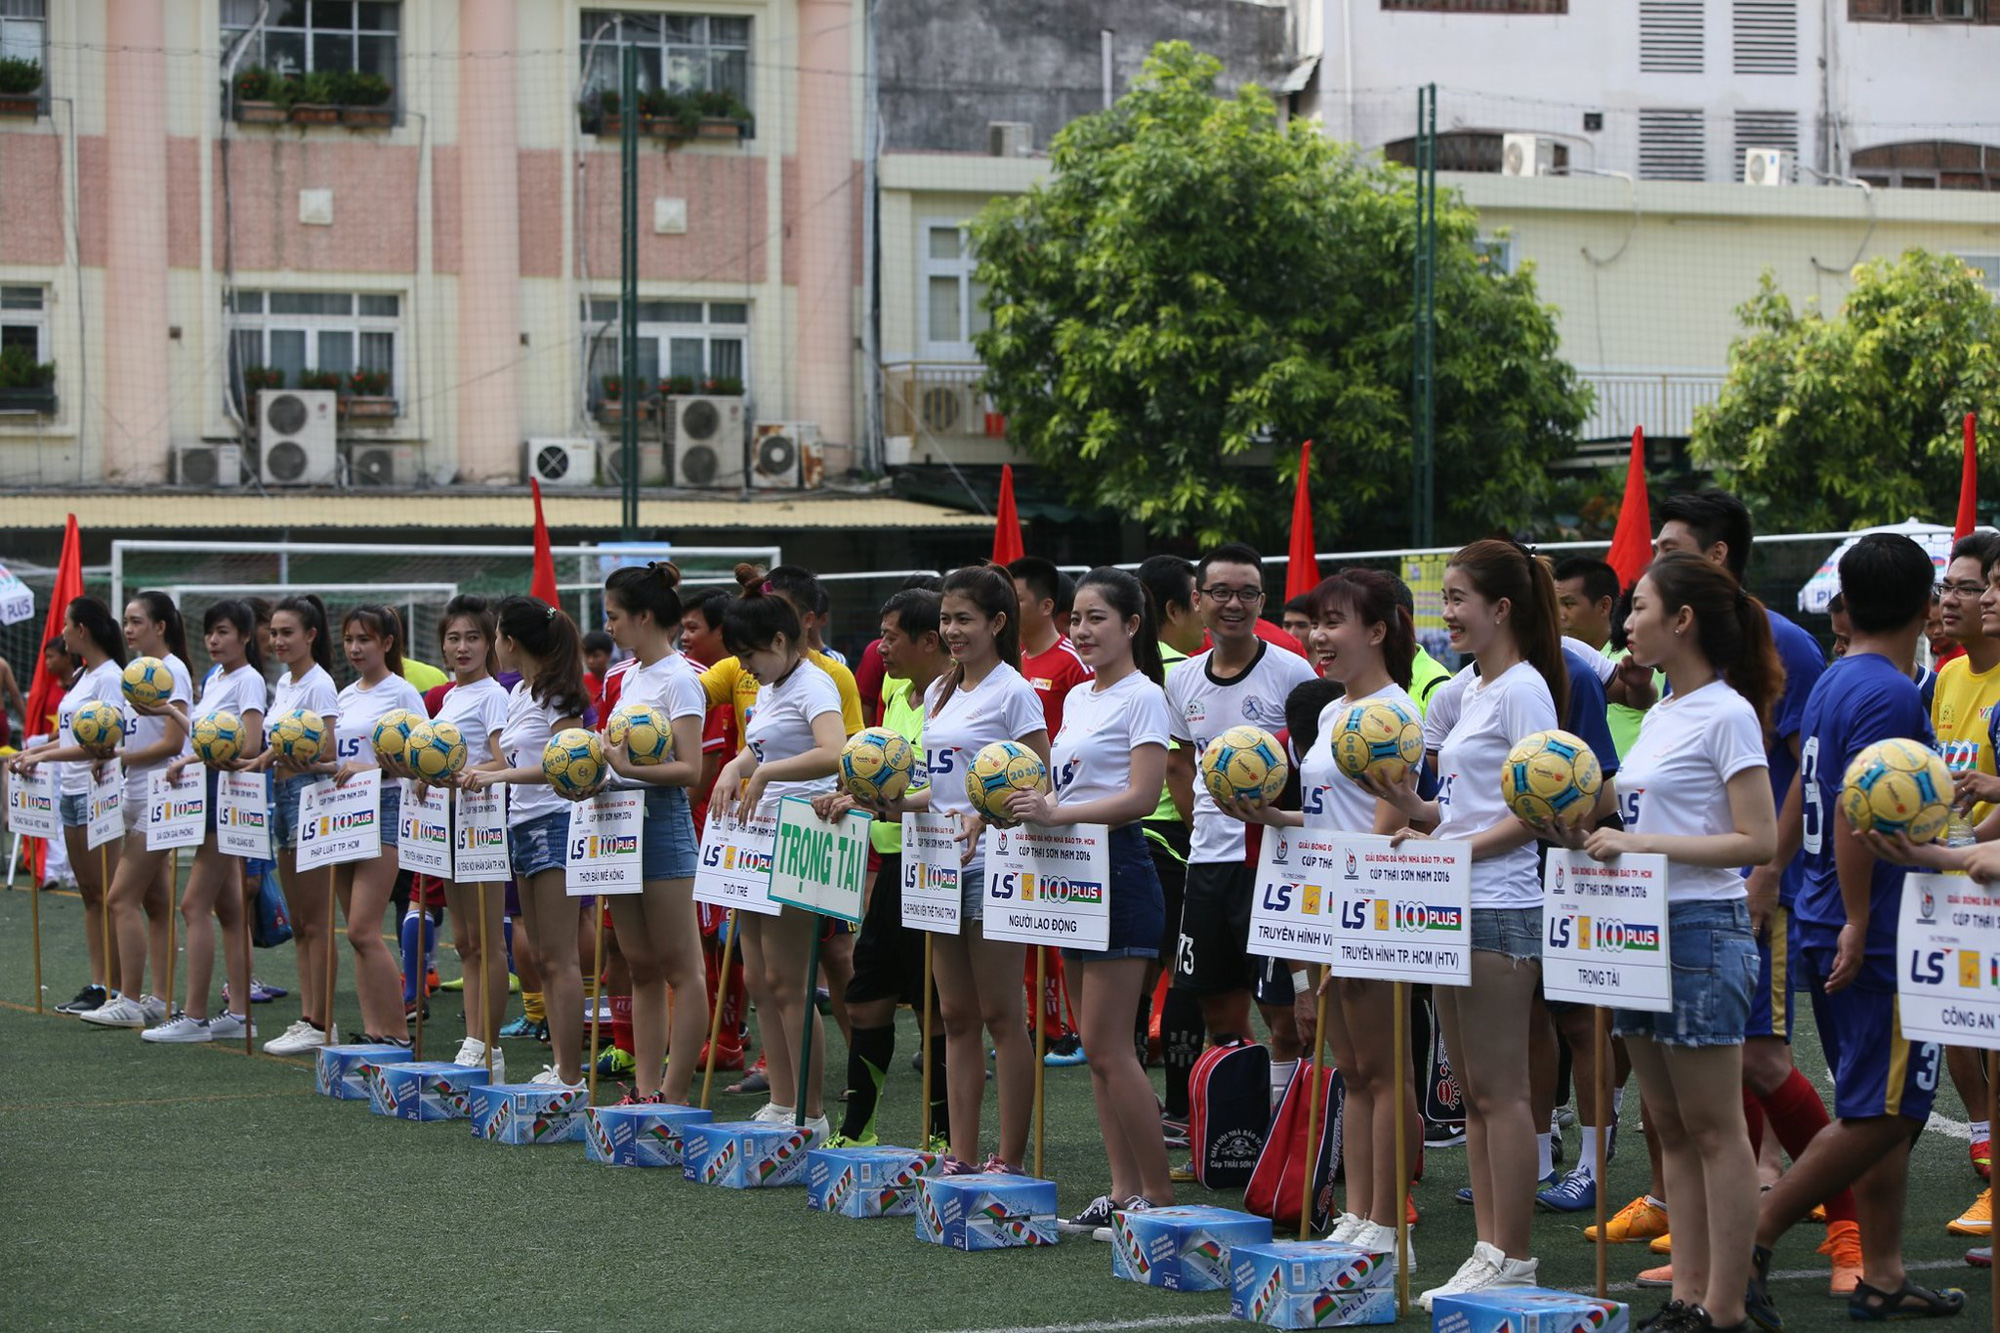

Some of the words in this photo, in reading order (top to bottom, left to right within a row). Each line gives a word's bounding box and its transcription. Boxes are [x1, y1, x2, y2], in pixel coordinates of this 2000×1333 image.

[338, 738, 359, 757] LS
[927, 749, 954, 773] LS
[915, 769, 928, 779] IFA
[1052, 763, 1074, 791] LS
[1302, 785, 1323, 815] LS
[1619, 793, 1640, 825] LS
[302, 821, 315, 841] LS
[348, 840, 360, 850] HCM
[571, 839, 584, 859] LS
[703, 845, 720, 867] LS
[1019, 844, 1030, 856] CÚP
[1031, 846, 1044, 858] THÁI
[1046, 847, 1059, 859] SƠN
[1060, 849, 1074, 860] NAM
[1076, 850, 1091, 861] 2016
[779, 822, 833, 893] TRỌNG
[837, 823, 863, 893] TÀI
[1301, 854, 1317, 867] CÚP
[905, 864, 915, 888] LS
[991, 873, 1014, 899] LS
[1370, 867, 1382, 880] CÚP
[1384, 867, 1399, 881] THÁI
[1401, 869, 1414, 881] SƠN
[1416, 871, 1432, 883] NAM
[1433, 871, 1450, 883] 2016
[1263, 884, 1292, 911] LS
[1631, 886, 1647, 898] 2016
[1009, 914, 1033, 927] NGƯỜI
[1034, 916, 1050, 930] LAO
[1052, 918, 1077, 934] ĐỘNG
[1342, 901, 1365, 929] LS
[1953, 911, 1970, 926] CÚP
[1973, 913, 1995, 929] THÁI
[1258, 925, 1294, 942] TRUYỀN
[1297, 928, 1320, 945] HÌNH
[1323, 933, 1332, 946] VI
[1550, 917, 1570, 948] LS
[1180, 933, 1194, 975] 73
[1341, 945, 1374, 962] TRUYỀN
[1376, 947, 1396, 964] HÌNH
[1398, 949, 1410, 964] TP.
[1412, 950, 1433, 965] HCM
[1435, 950, 1459, 969] (HTV)
[1578, 968, 1604, 988] TRỌNG
[1606, 968, 1620, 987] TÀI
[1911, 950, 1945, 985] LS
[1942, 1007, 1975, 1027] CÔNG
[1978, 1012, 1994, 1030] AN
[1917, 1042, 1940, 1091] 3
[1210, 1160, 1223, 1169] Cúp
[1223, 1159, 1239, 1168] THÁI
[1209, 1267, 1231, 1287] PLU
